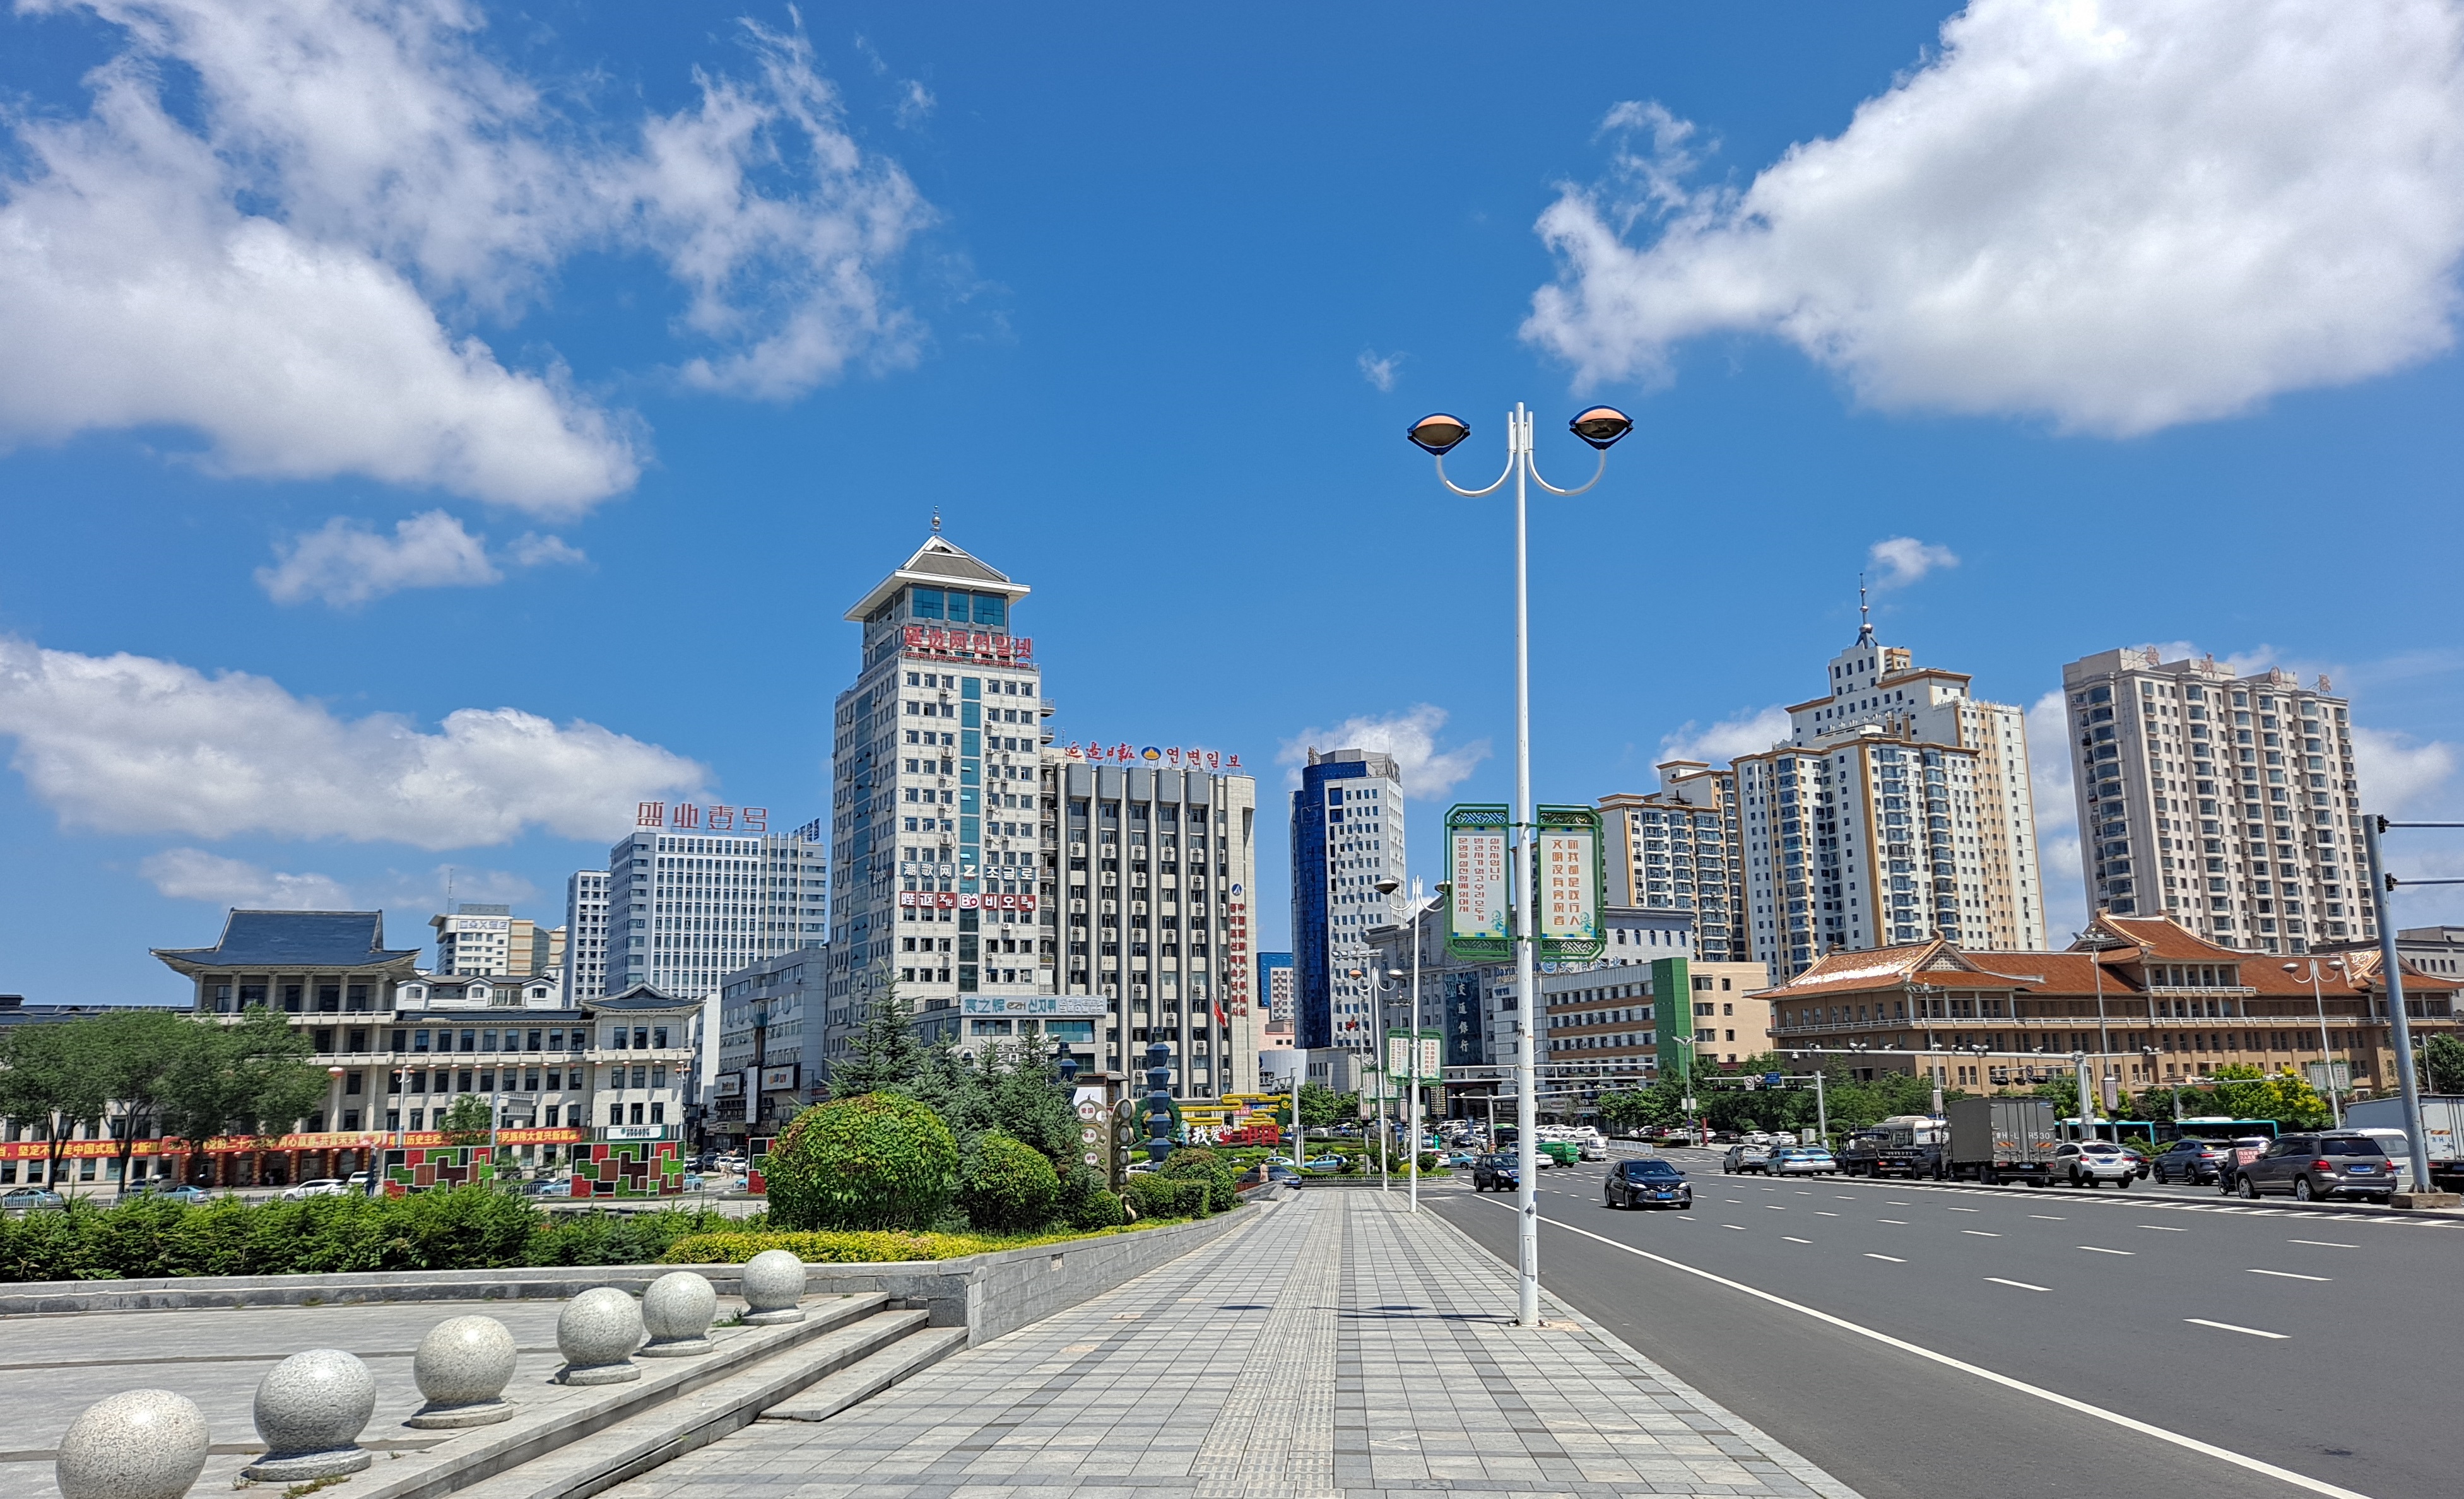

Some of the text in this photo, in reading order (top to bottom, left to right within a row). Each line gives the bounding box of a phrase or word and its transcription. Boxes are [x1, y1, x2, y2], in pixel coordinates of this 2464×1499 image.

[904, 626, 969, 652] 延边网
[1166, 746, 1242, 768] 연변일보
[636, 801, 768, 832] 盛业壹号
[903, 862, 952, 878] 潮歌网
[986, 866, 1034, 881] 조글로
[1552, 839, 1564, 926] 文明没有旁观者
[1567, 839, 1580, 926] 你我都是践行人
[1473, 884, 1485, 898] 우리
[1474, 900, 1485, 922] 모두가
